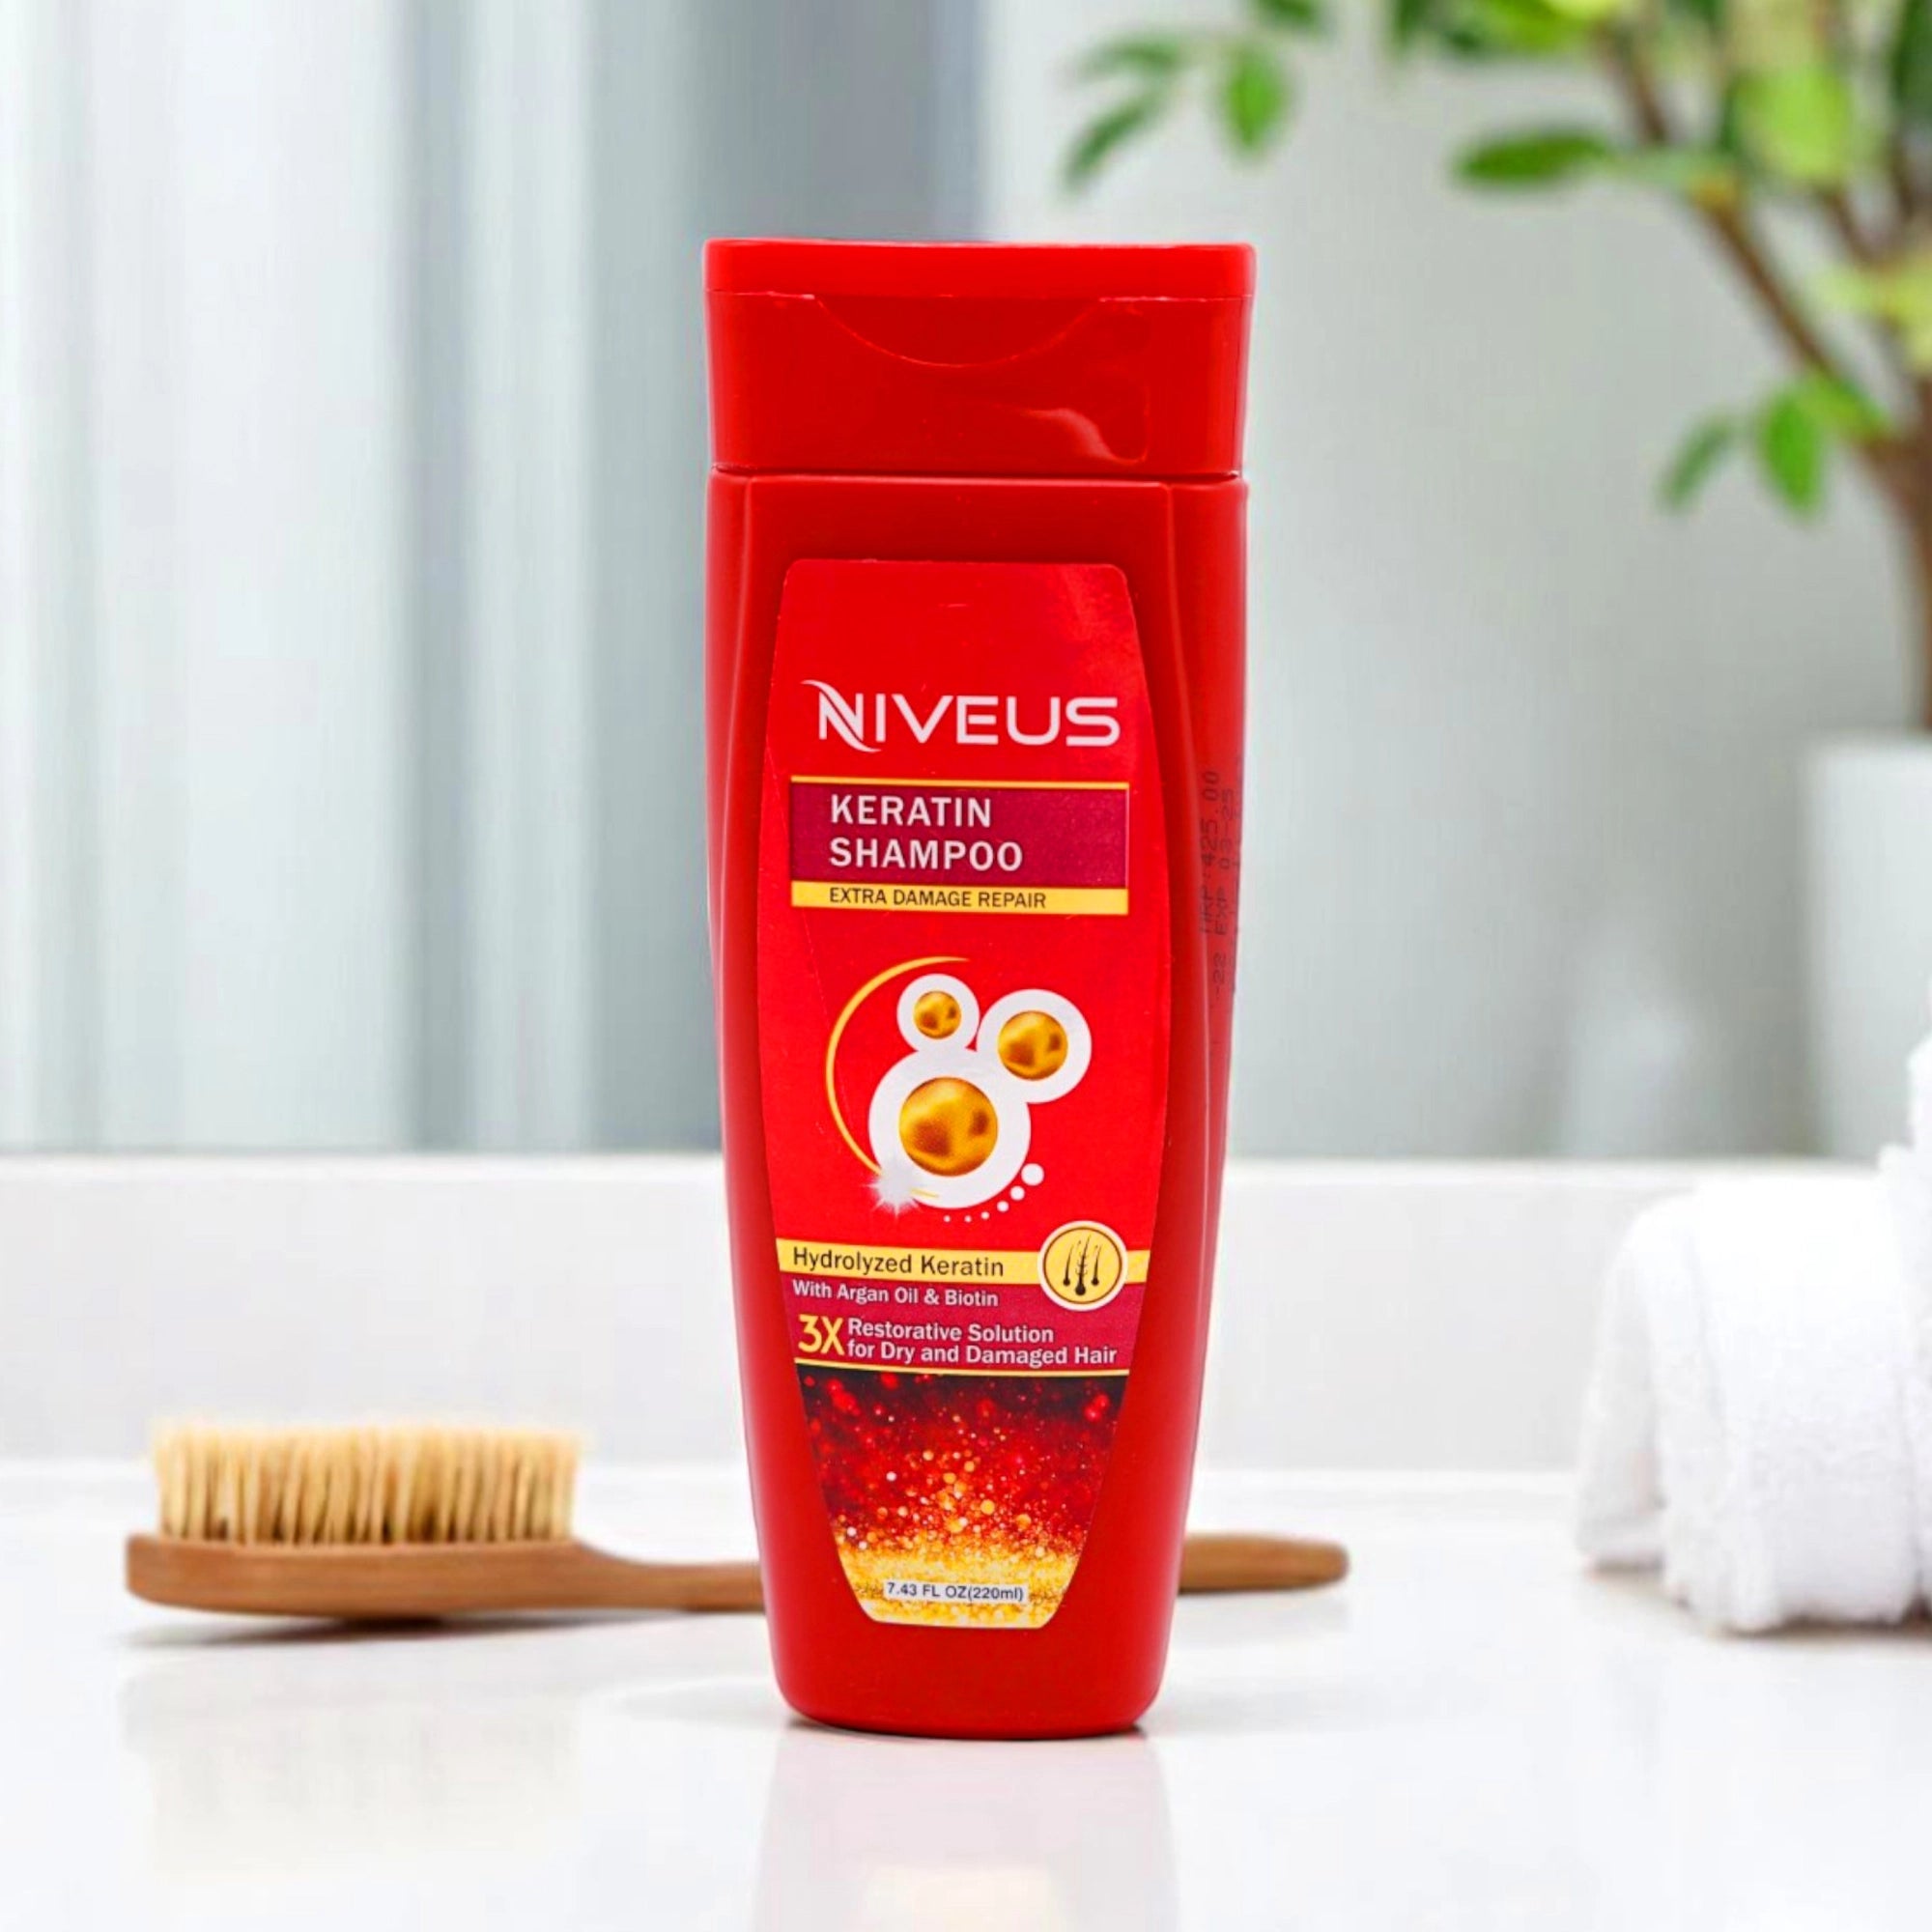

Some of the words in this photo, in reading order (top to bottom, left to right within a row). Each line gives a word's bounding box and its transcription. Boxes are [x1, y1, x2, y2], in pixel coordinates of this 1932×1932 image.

[801, 679, 1121, 753] NIVEUS
[831, 795, 991, 828] KERATIN
[830, 838, 1023, 871] SHAMPOO
[830, 888, 887, 904] EXTRA
[893, 890, 972, 907] DAMAGE
[979, 893, 1046, 908] REPAIR
[793, 1246, 912, 1274] Hydrolyzed
[921, 1255, 1004, 1277] Keratin
[792, 1280, 832, 1298] With
[837, 1287, 889, 1307] Argan
[895, 1288, 918, 1303] Oil
[924, 1290, 939, 1304] &
[946, 1290, 999, 1307] Biotin
[798, 1314, 845, 1356] 3X
[848, 1320, 962, 1341] Restorative
[968, 1324, 1054, 1343] Solution
[847, 1339, 874, 1358] for
[880, 1342, 915, 1364] Dry
[921, 1345, 958, 1362] and
[966, 1346, 1067, 1369] Damaged
[1074, 1348, 1118, 1364] Hair
[887, 1582, 917, 1597] 7.43
[923, 1585, 940, 1598] FL
